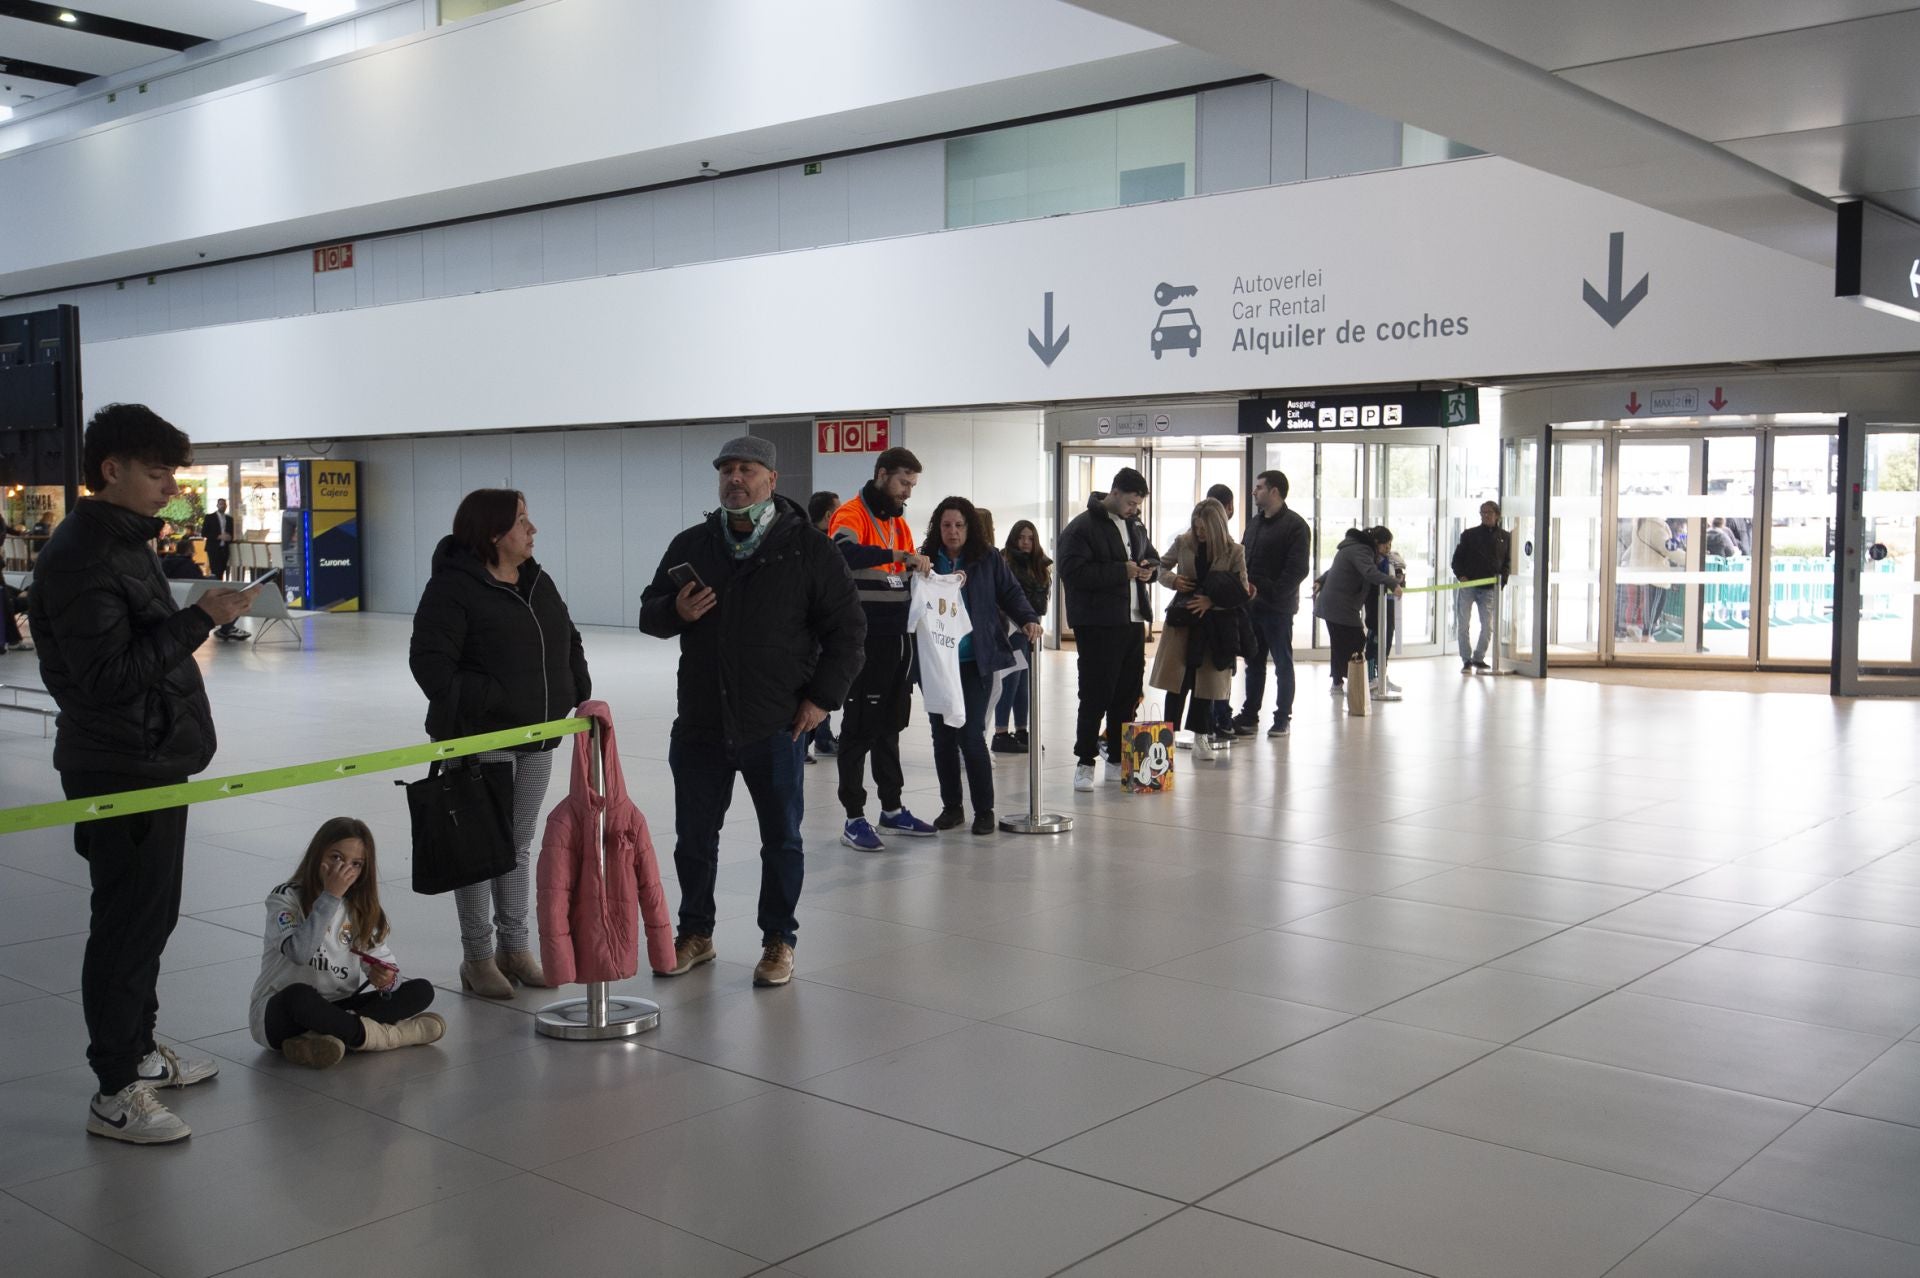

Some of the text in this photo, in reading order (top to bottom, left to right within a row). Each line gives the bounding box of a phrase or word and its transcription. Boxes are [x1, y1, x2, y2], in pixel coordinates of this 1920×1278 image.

[1232, 268, 1323, 295] Autoverlei
[1232, 294, 1326, 320] Car Rental
[1232, 313, 1469, 355] Alquiler de coches
[1287, 400, 1316, 410] Ausgang
[1287, 410, 1300, 419] Exit
[1366, 409, 1376, 422] P
[1287, 419, 1314, 429] Salida
[318, 472, 352, 485] ATM
[320, 487, 349, 498] Cajero
